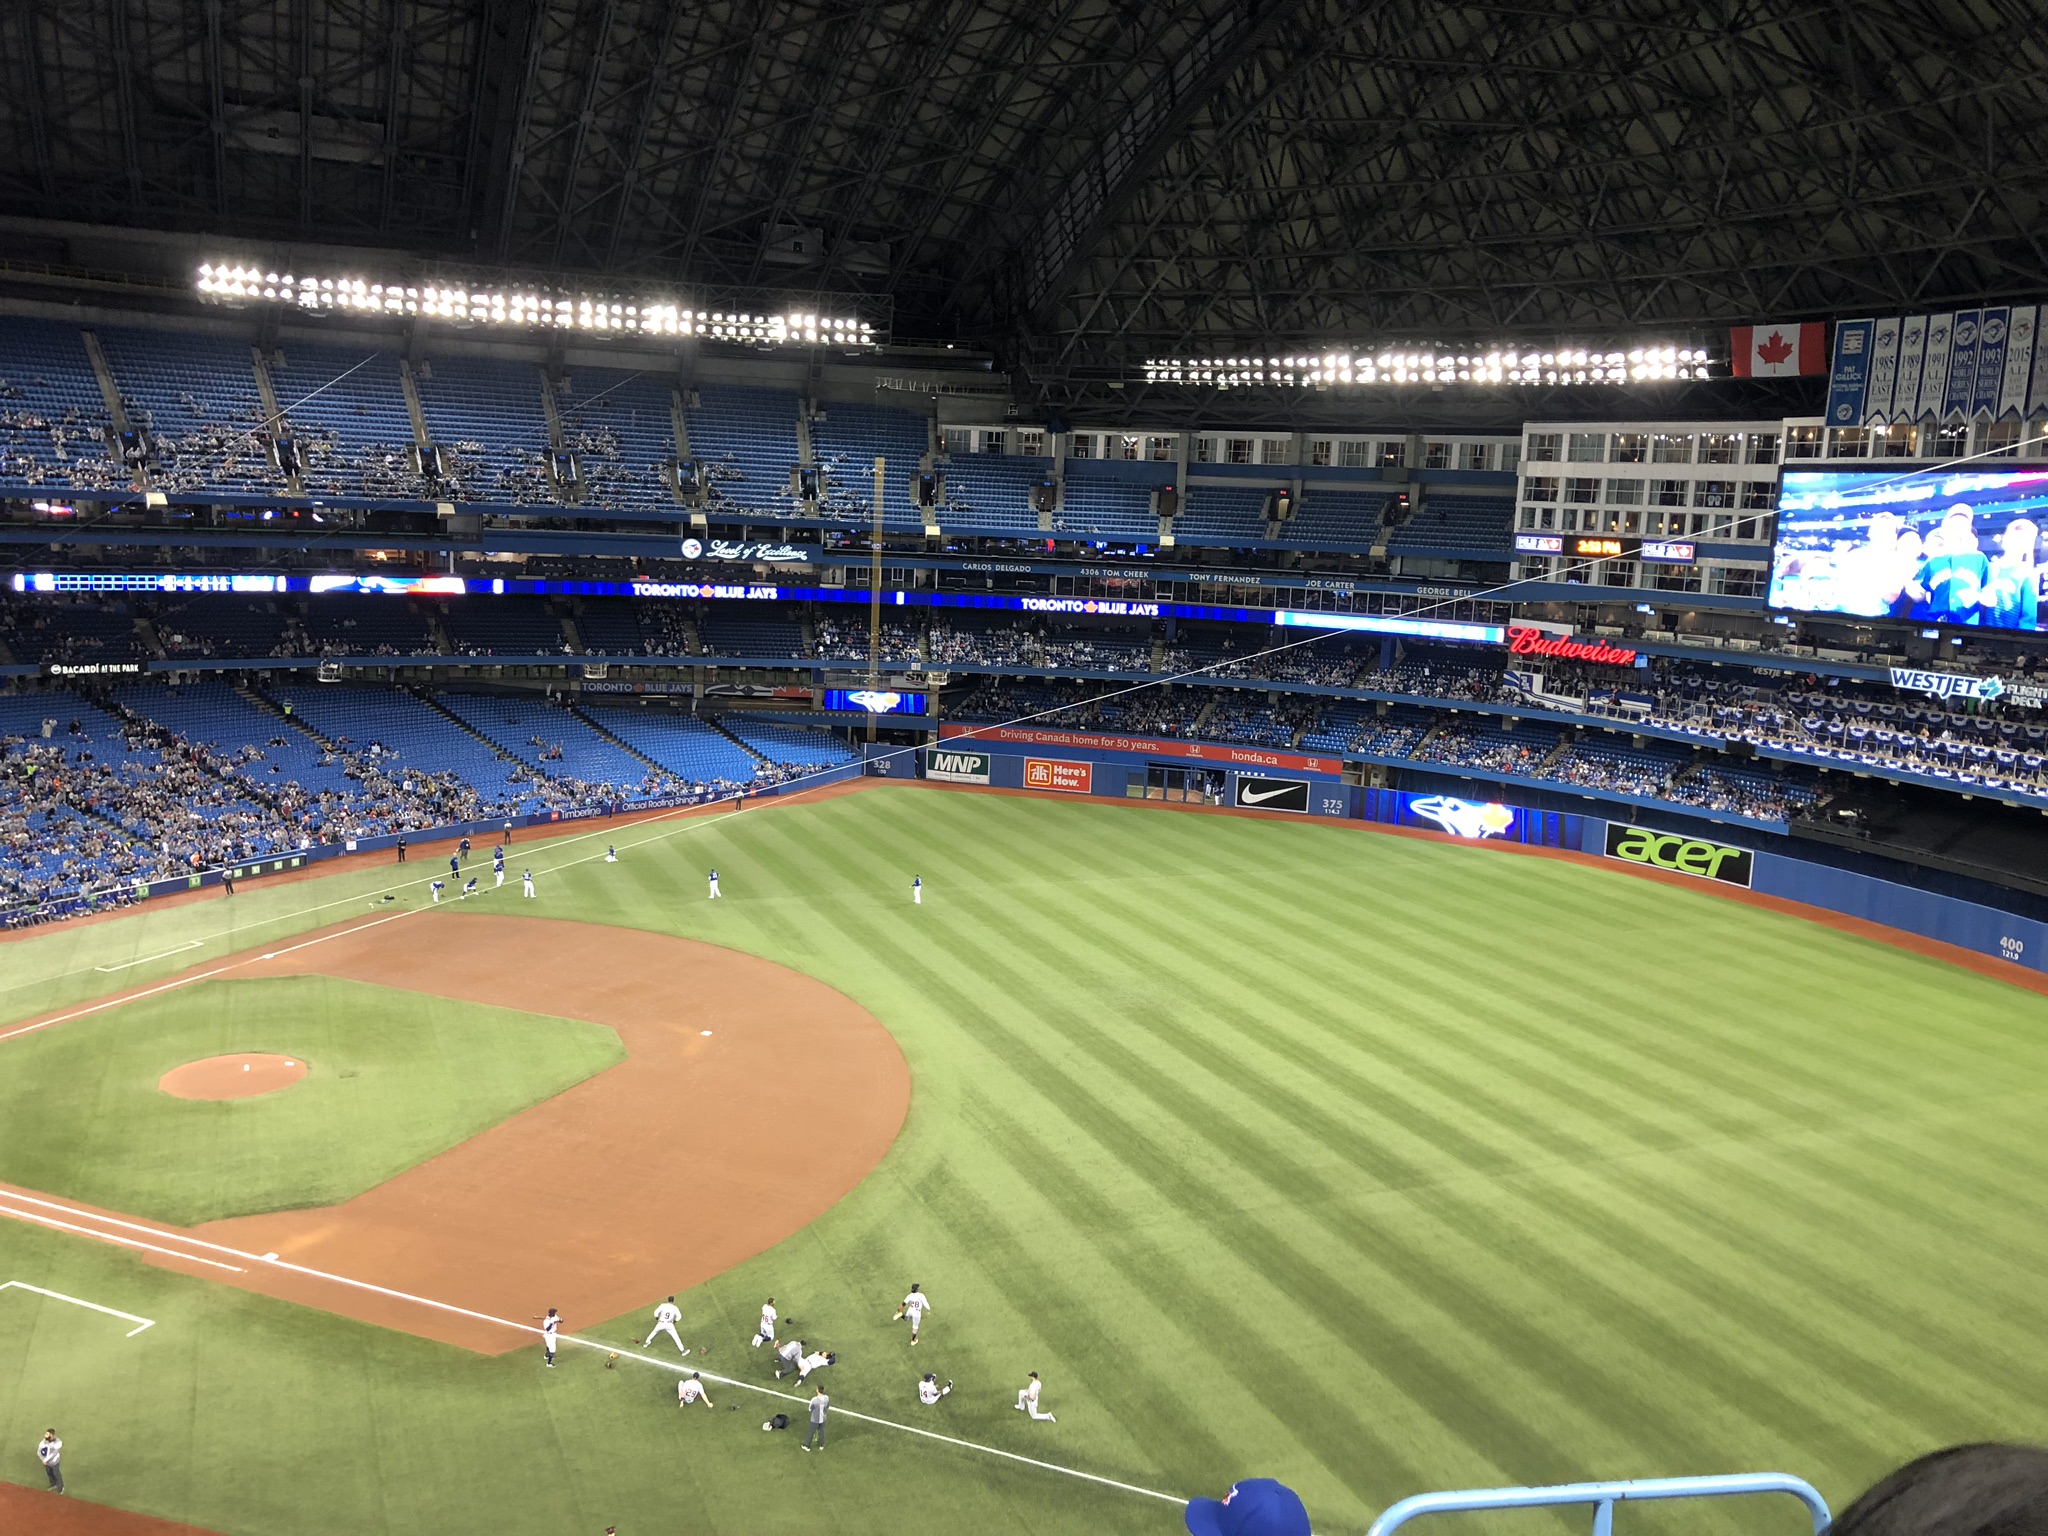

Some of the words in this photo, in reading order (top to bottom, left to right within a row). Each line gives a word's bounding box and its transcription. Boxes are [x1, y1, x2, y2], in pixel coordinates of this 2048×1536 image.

[1954, 350, 1973, 367] 1992
[1981, 348, 2001, 365] 1993
[2008, 346, 2030, 362] 2015
[1874, 355, 1894, 370] 1985
[706, 540, 742, 559] Level
[743, 541, 755, 560] of
[756, 543, 808, 560] Excellence
[962, 563, 992, 571] CARLOS
[995, 564, 1031, 572] DELGADO
[1080, 568, 1099, 576] 4306
[1102, 569, 1120, 577] TOM
[1124, 570, 1150, 578] CHEEK
[1189, 574, 1211, 582] TONY
[1214, 574, 1261, 584] FERNANDEZ
[1325, 581, 1355, 590] CARTER
[633, 582, 699, 598] TORONTO
[714, 585, 744, 599] BLUE
[746, 587, 777, 600] JAYS
[1416, 586, 1451, 596] GEORGE
[1453, 588, 1472, 597] BELL
[1022, 598, 1083, 612] TORONTO
[1098, 602, 1127, 615] BLUE
[1129, 604, 1159, 616] JAYS
[1507, 626, 1637, 666] Budweiser
[109, 664, 120, 672] THE
[122, 664, 139, 672] PARK
[581, 682, 632, 692] TORONTO
[644, 683, 667, 693] BLUE
[669, 684, 692, 694] JAYS
[1892, 669, 1978, 697] WESTJET
[2006, 684, 2048, 698] FLIGHT
[2010, 695, 2042, 708] DECK
[1000, 730, 1034, 742] Driving
[1036, 732, 1070, 744] Canada
[1072, 734, 1098, 745] home
[1101, 736, 1114, 746] for
[1117, 739, 1128, 748] 50
[1131, 742, 1160, 751] years.
[934, 754, 982, 773] MNP
[1232, 750, 1278, 765] honda.ca
[873, 760, 891, 770] 328
[1054, 764, 1087, 777] Here's
[1053, 776, 1080, 787] How.
[622, 799, 647, 811] Official
[648, 798, 674, 809] Roofing
[675, 794, 700, 806] Shingle
[1322, 799, 1343, 809] 375
[560, 807, 602, 819] Timberline
[1616, 828, 1741, 878] acer
[2000, 936, 2024, 953] 400
[2002, 950, 2019, 960] 121.9
[665, 1312, 670, 1320] 9
[686, 1389, 696, 1398] 29
[920, 1390, 928, 1398] 14
